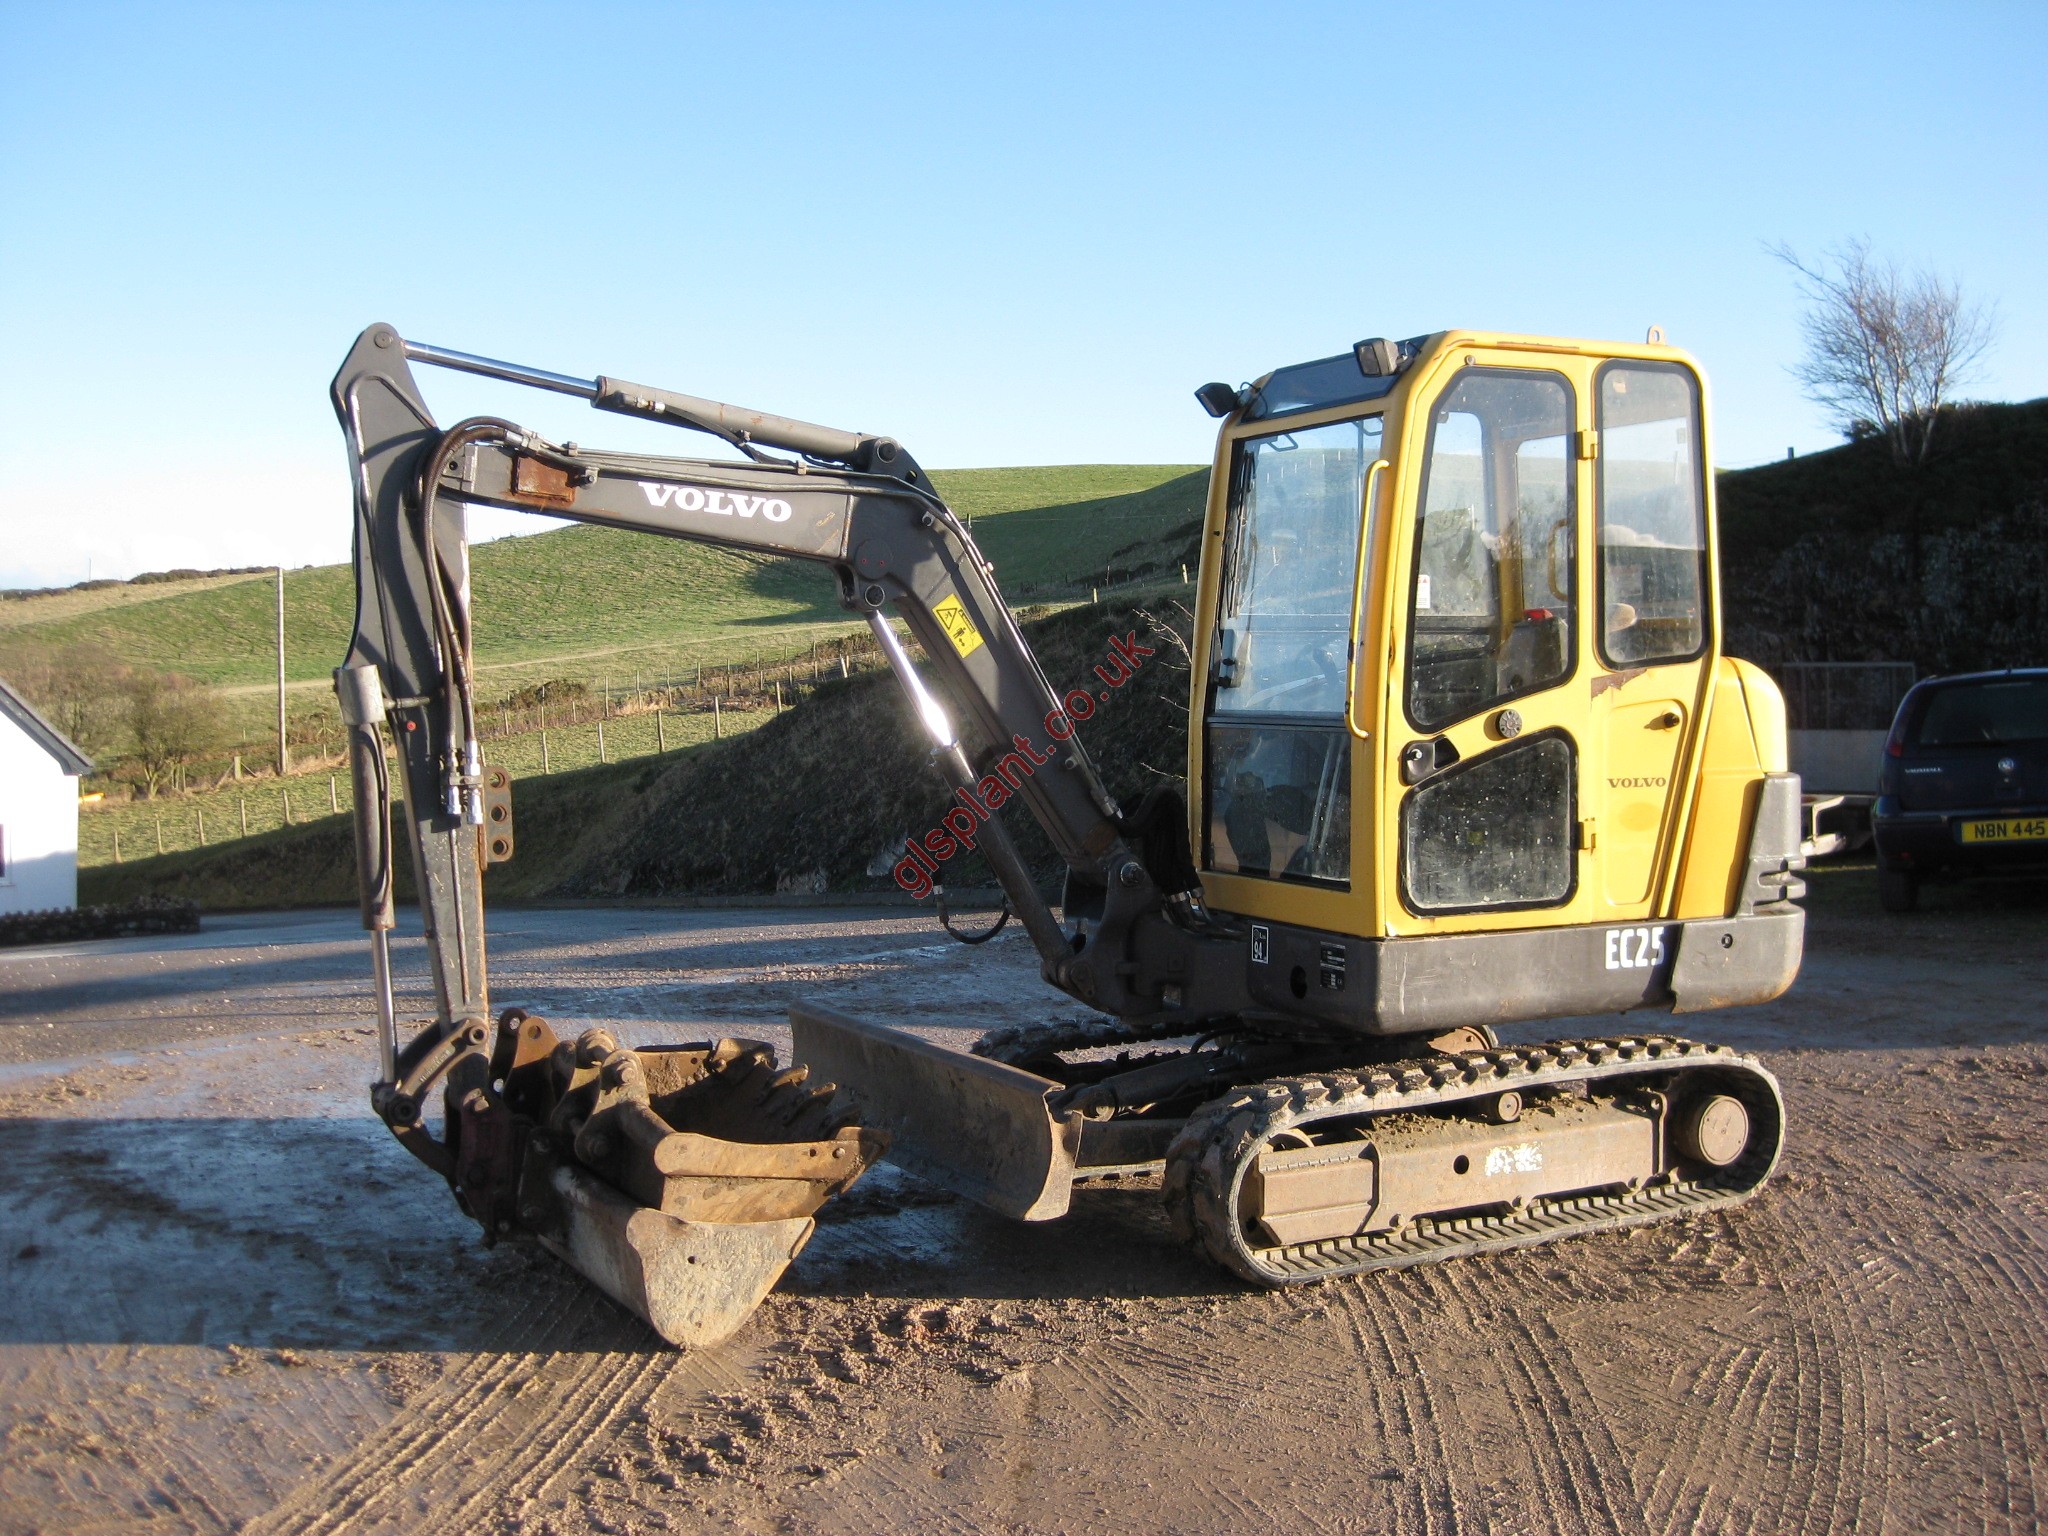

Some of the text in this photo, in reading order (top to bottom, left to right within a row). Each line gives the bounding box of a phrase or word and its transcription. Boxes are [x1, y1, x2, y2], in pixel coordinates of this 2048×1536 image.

[638, 481, 792, 522] VOLVO
[1607, 777, 1667, 789] VOLVO
[1974, 821, 2046, 839] NBN 445
[1254, 941, 1262, 959] 94
[1605, 927, 1665, 970] EC25
